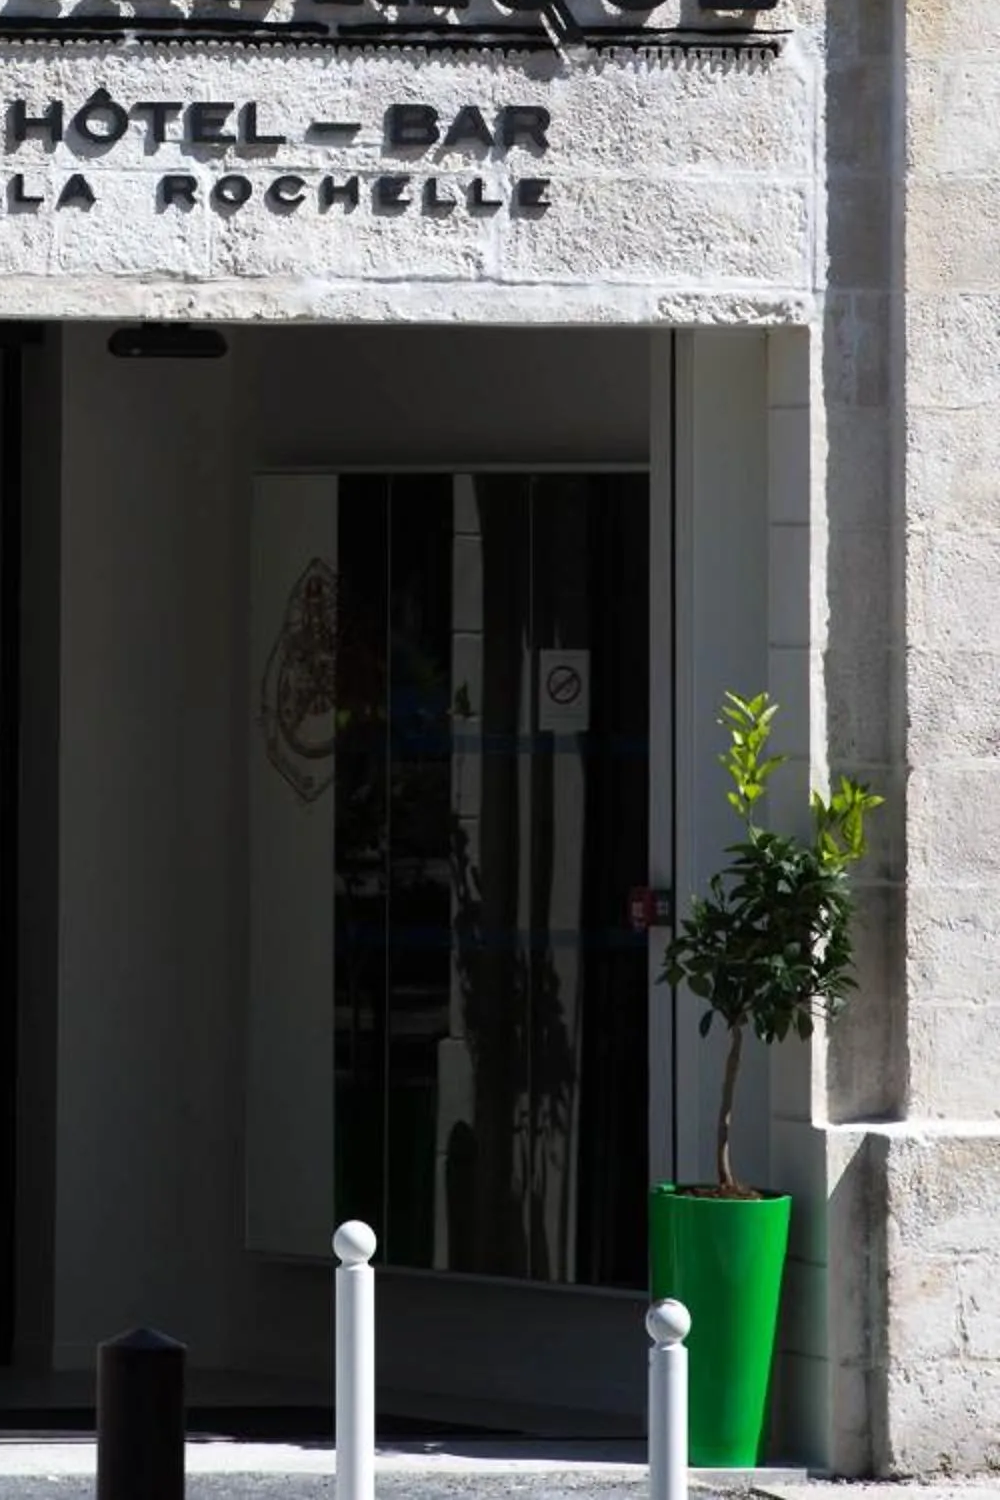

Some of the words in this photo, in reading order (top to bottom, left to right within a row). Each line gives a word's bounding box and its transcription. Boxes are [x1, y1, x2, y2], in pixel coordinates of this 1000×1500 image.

[12, 86, 287, 145] HÔTEL
[388, 103, 551, 149] BAR
[14, 173, 97, 205] LA
[161, 174, 552, 207] ROCHELLE
